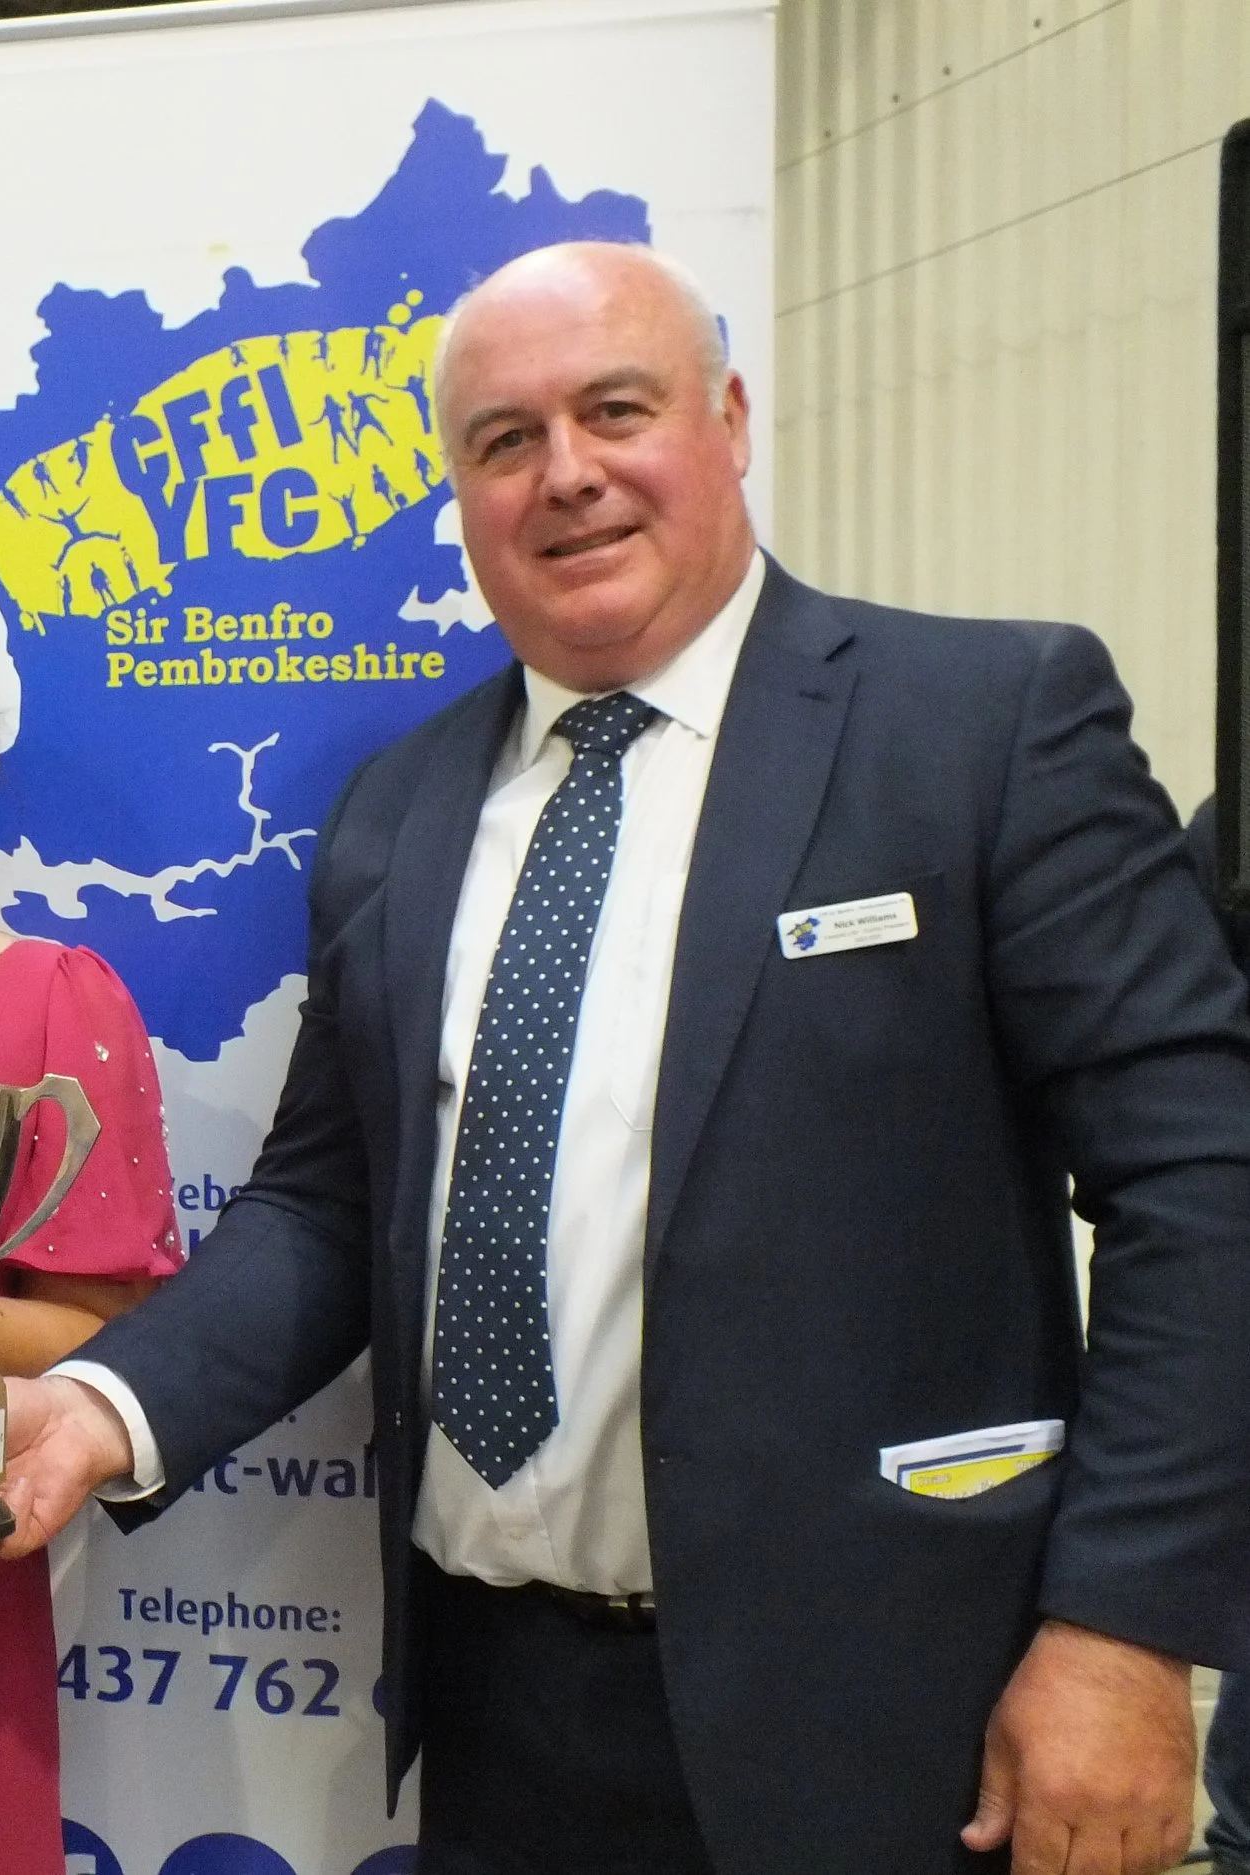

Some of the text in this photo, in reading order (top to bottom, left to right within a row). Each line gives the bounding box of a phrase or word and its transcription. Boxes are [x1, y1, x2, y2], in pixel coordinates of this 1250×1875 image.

[140, 467, 320, 565] YFC
[106, 603, 334, 645] Sir Benfro
[105, 643, 446, 688] Pembrokeshire
[857, 913, 898, 925] Williams
[118, 1586, 342, 1636] Telephone:
[209, 1654, 341, 1717] 762
